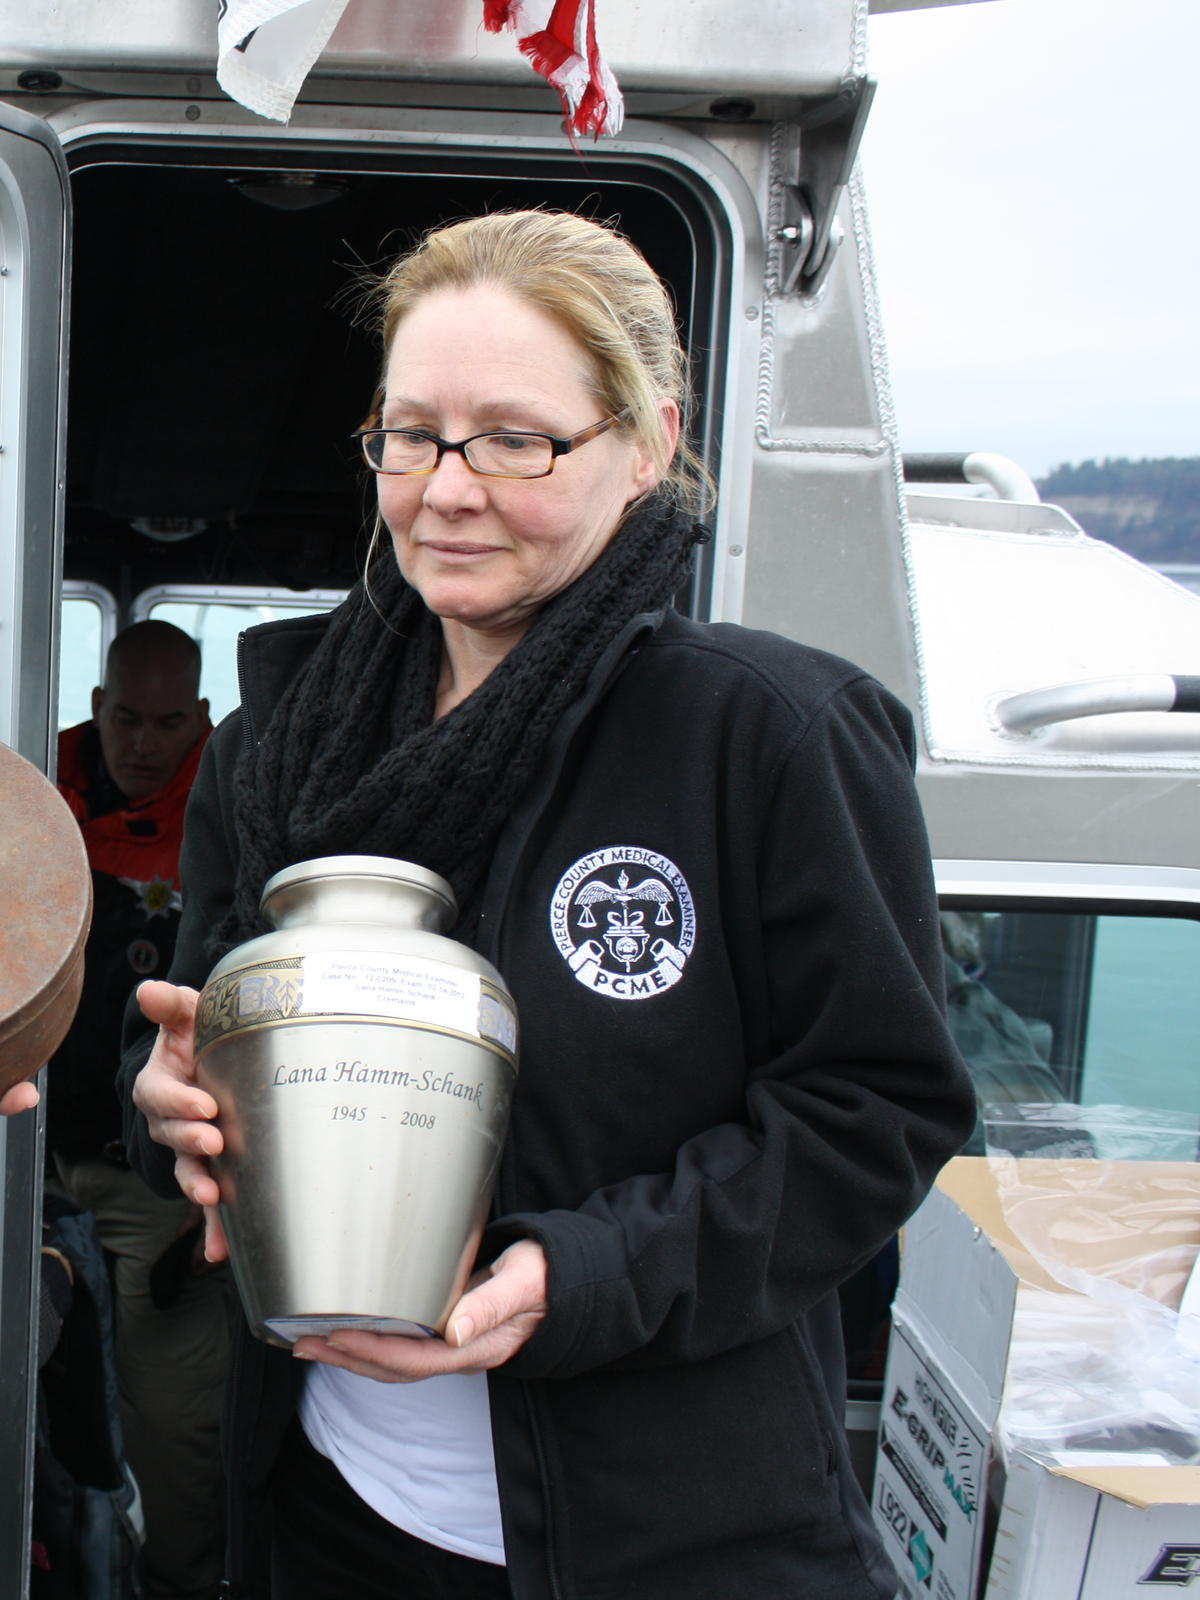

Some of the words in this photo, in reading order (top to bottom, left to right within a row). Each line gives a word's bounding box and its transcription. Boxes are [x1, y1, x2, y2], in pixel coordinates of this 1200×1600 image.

[559, 852, 605, 900] COUNTY
[611, 849, 672, 878] MEDICAL
[554, 902, 572, 951] PIERCE
[671, 873, 695, 948] EXAMINER
[593, 970, 667, 996] PCME
[272, 1064, 328, 1088] Lana
[332, 1060, 484, 1112] Hamm-Schank
[330, 1104, 368, 1123] 1945
[399, 1110, 437, 1130] 2008
